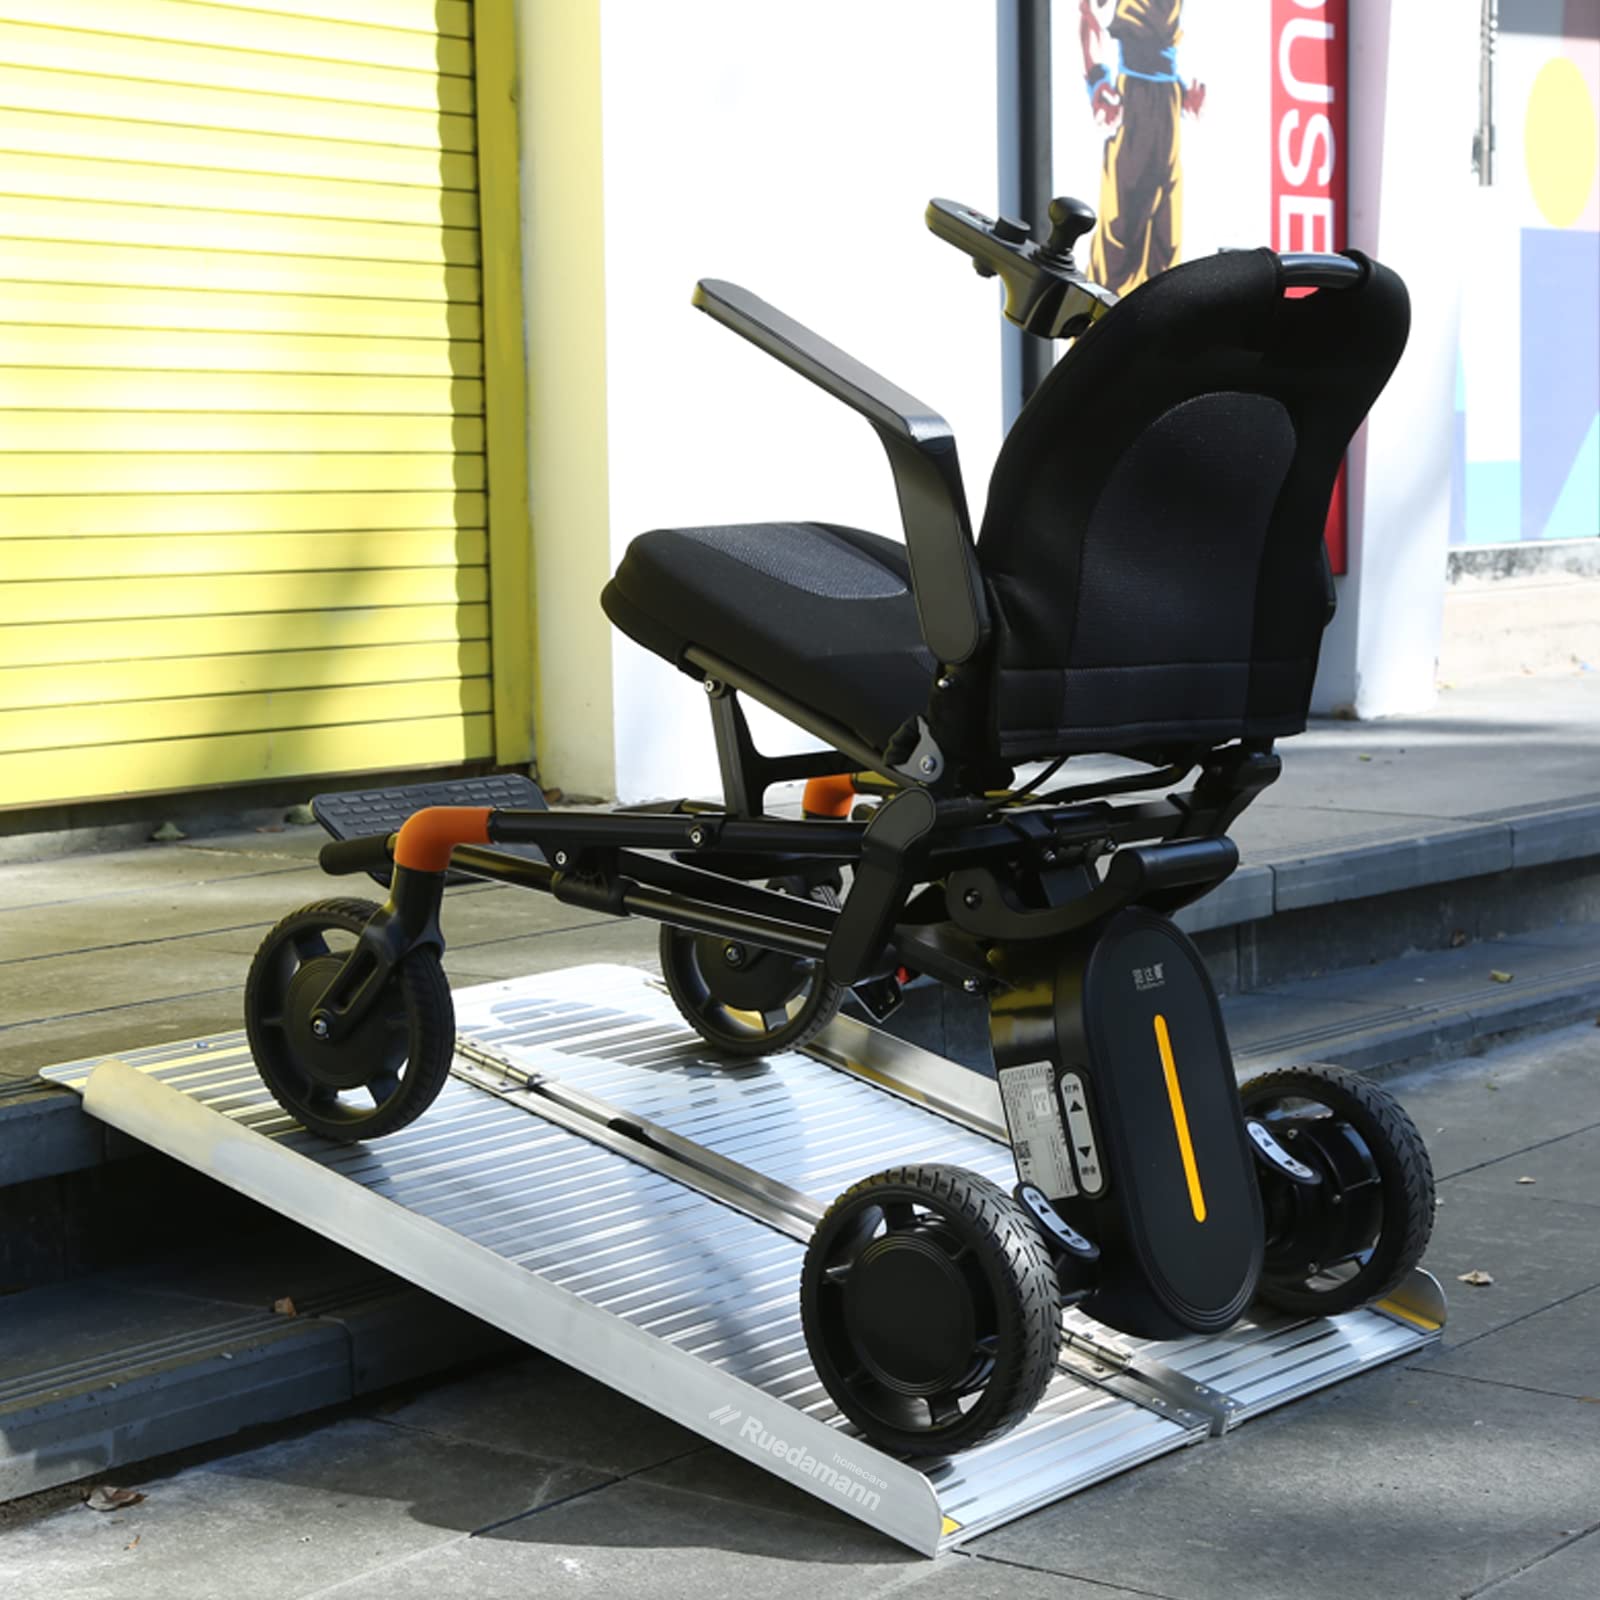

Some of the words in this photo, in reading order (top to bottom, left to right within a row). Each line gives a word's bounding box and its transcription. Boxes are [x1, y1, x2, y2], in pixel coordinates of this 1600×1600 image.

[1278, 0, 1336, 254] USE
[738, 1415, 882, 1512] Ruedamann
[832, 1452, 888, 1490] homecare
